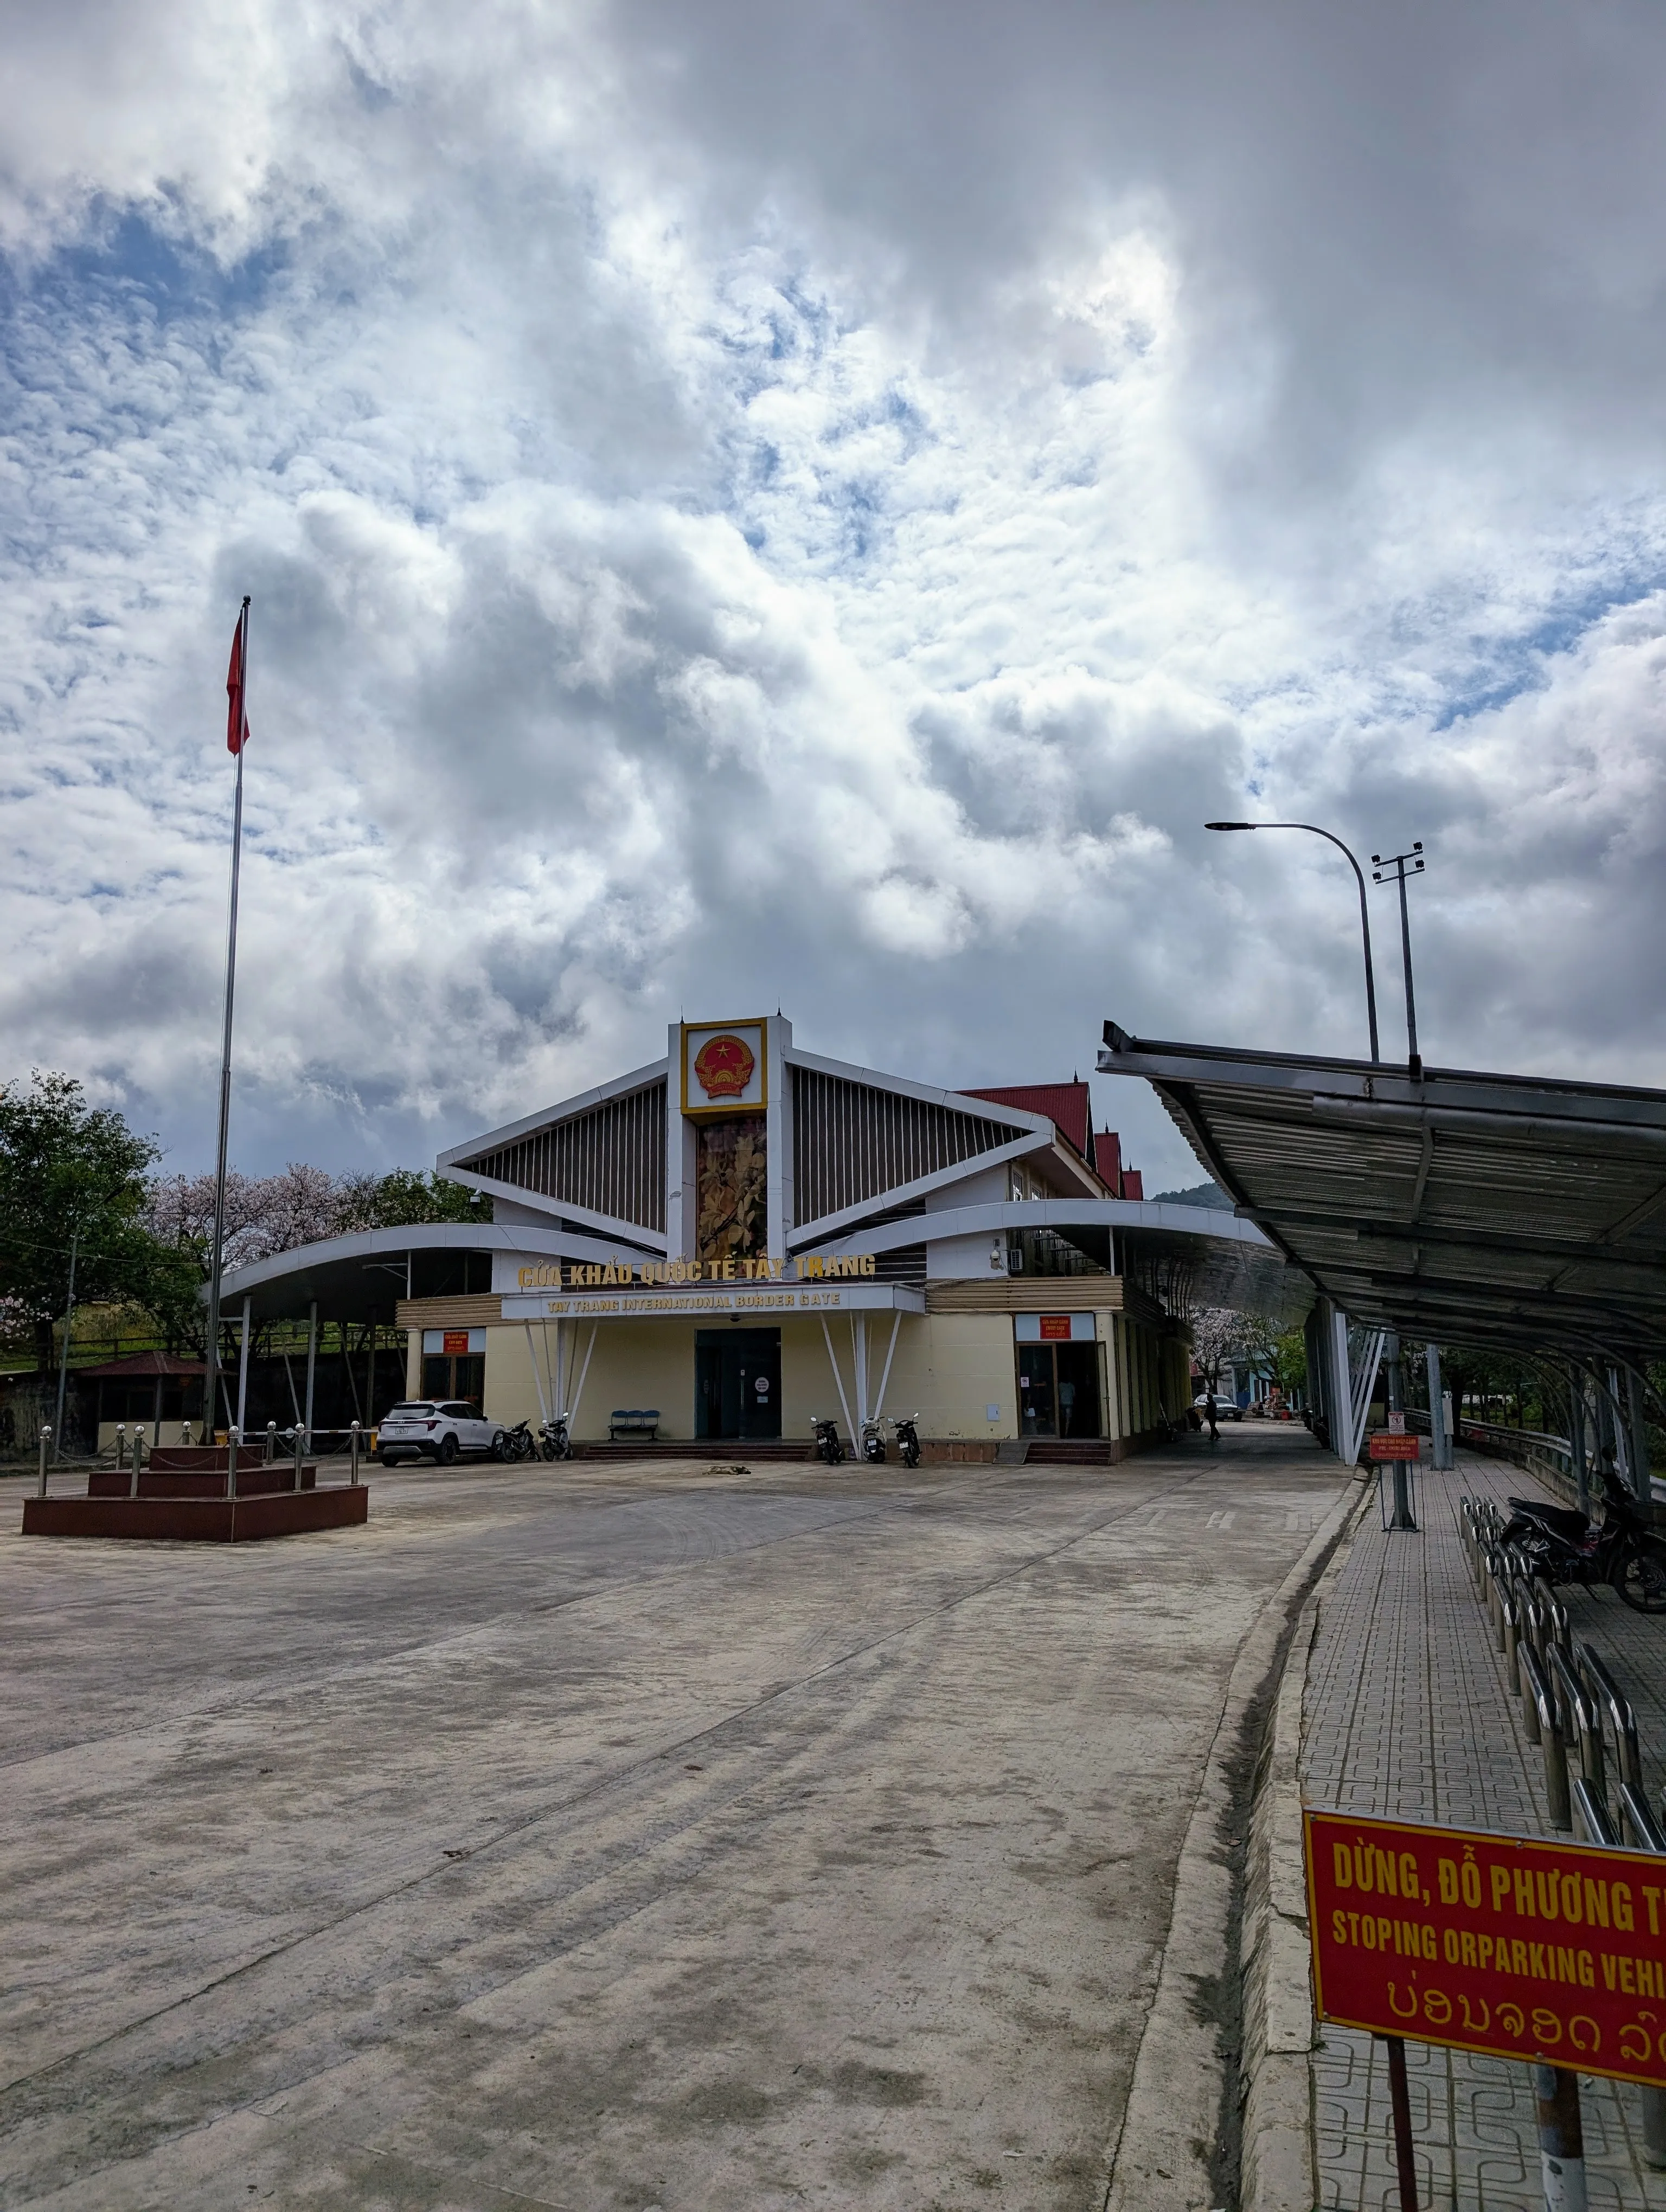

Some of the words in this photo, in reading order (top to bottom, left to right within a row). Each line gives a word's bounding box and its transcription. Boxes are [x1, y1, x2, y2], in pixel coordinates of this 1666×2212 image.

[518, 1259, 562, 1287] CỬA
[570, 1254, 632, 1286] KHẨU
[640, 1253, 702, 1285] QUỐC
[708, 1251, 737, 1281] TẾ
[743, 1253, 784, 1279] TÂY
[794, 1254, 875, 1278] TRANG
[547, 1301, 571, 1313] TAY
[573, 1300, 619, 1311] TRANG
[621, 1296, 732, 1311] INTERNATIONAL
[735, 1294, 795, 1307] BORDER
[799, 1293, 841, 1305] GATE
[1332, 1836, 1431, 1907] DỪNG,
[1438, 1844, 1482, 1908] ĐỖ
[1489, 1864, 1635, 1933] PHƯƠNG
[1641, 1886, 1666, 1936] T
[1332, 1909, 1437, 1961] STOPING
[1444, 1928, 1595, 1988] ORPARKING
[1600, 1953, 1666, 1999] VEHI
